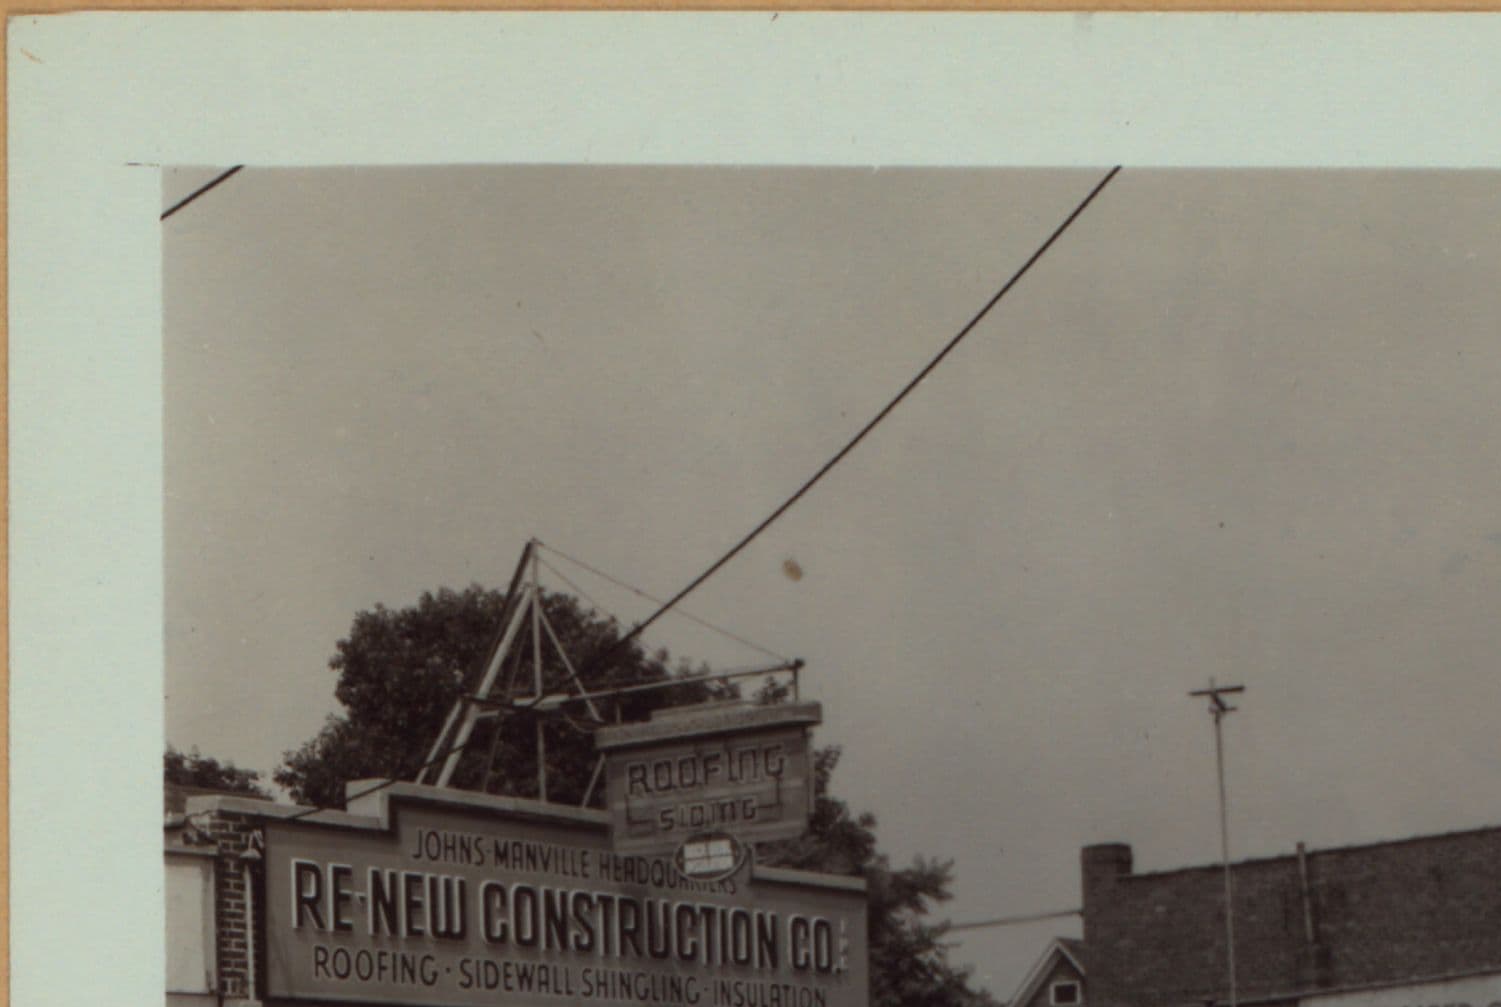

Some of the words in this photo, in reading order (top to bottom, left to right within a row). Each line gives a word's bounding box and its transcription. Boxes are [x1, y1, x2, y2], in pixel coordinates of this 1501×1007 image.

[627, 744, 784, 796] ROOFING
[658, 798, 757, 832] SIDING
[412, 830, 590, 879] JOHNS-MANVILLE
[291, 857, 468, 942] RE-NEW
[480, 878, 779, 970] CONSTRUCTION
[314, 945, 440, 987] ROOFING
[458, 957, 575, 997] SIDEWALL
[581, 967, 701, 1005] SHINGLING
